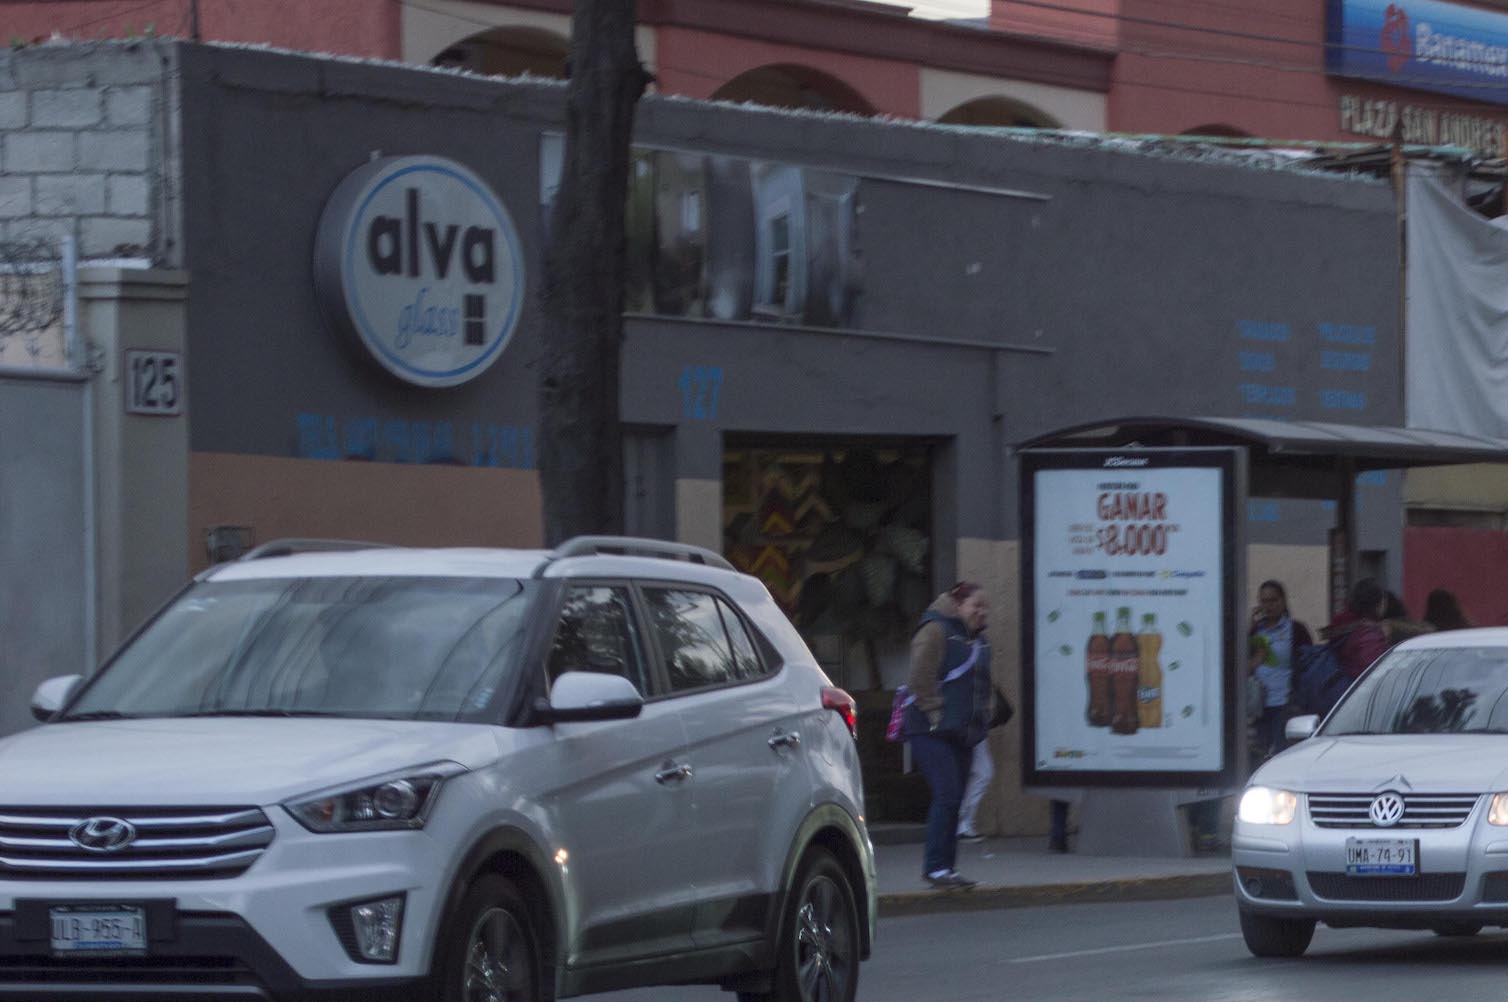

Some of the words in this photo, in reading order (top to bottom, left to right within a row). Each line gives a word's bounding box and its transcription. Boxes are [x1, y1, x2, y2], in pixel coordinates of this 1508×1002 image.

[1340, 96, 1397, 138] PLAZA
[1401, 105, 1439, 144] SAN
[368, 188, 497, 283] alva
[133, 358, 178, 408] 125
[1097, 492, 1168, 521] GANAR
[1348, 847, 1411, 864] UMA-74-91
